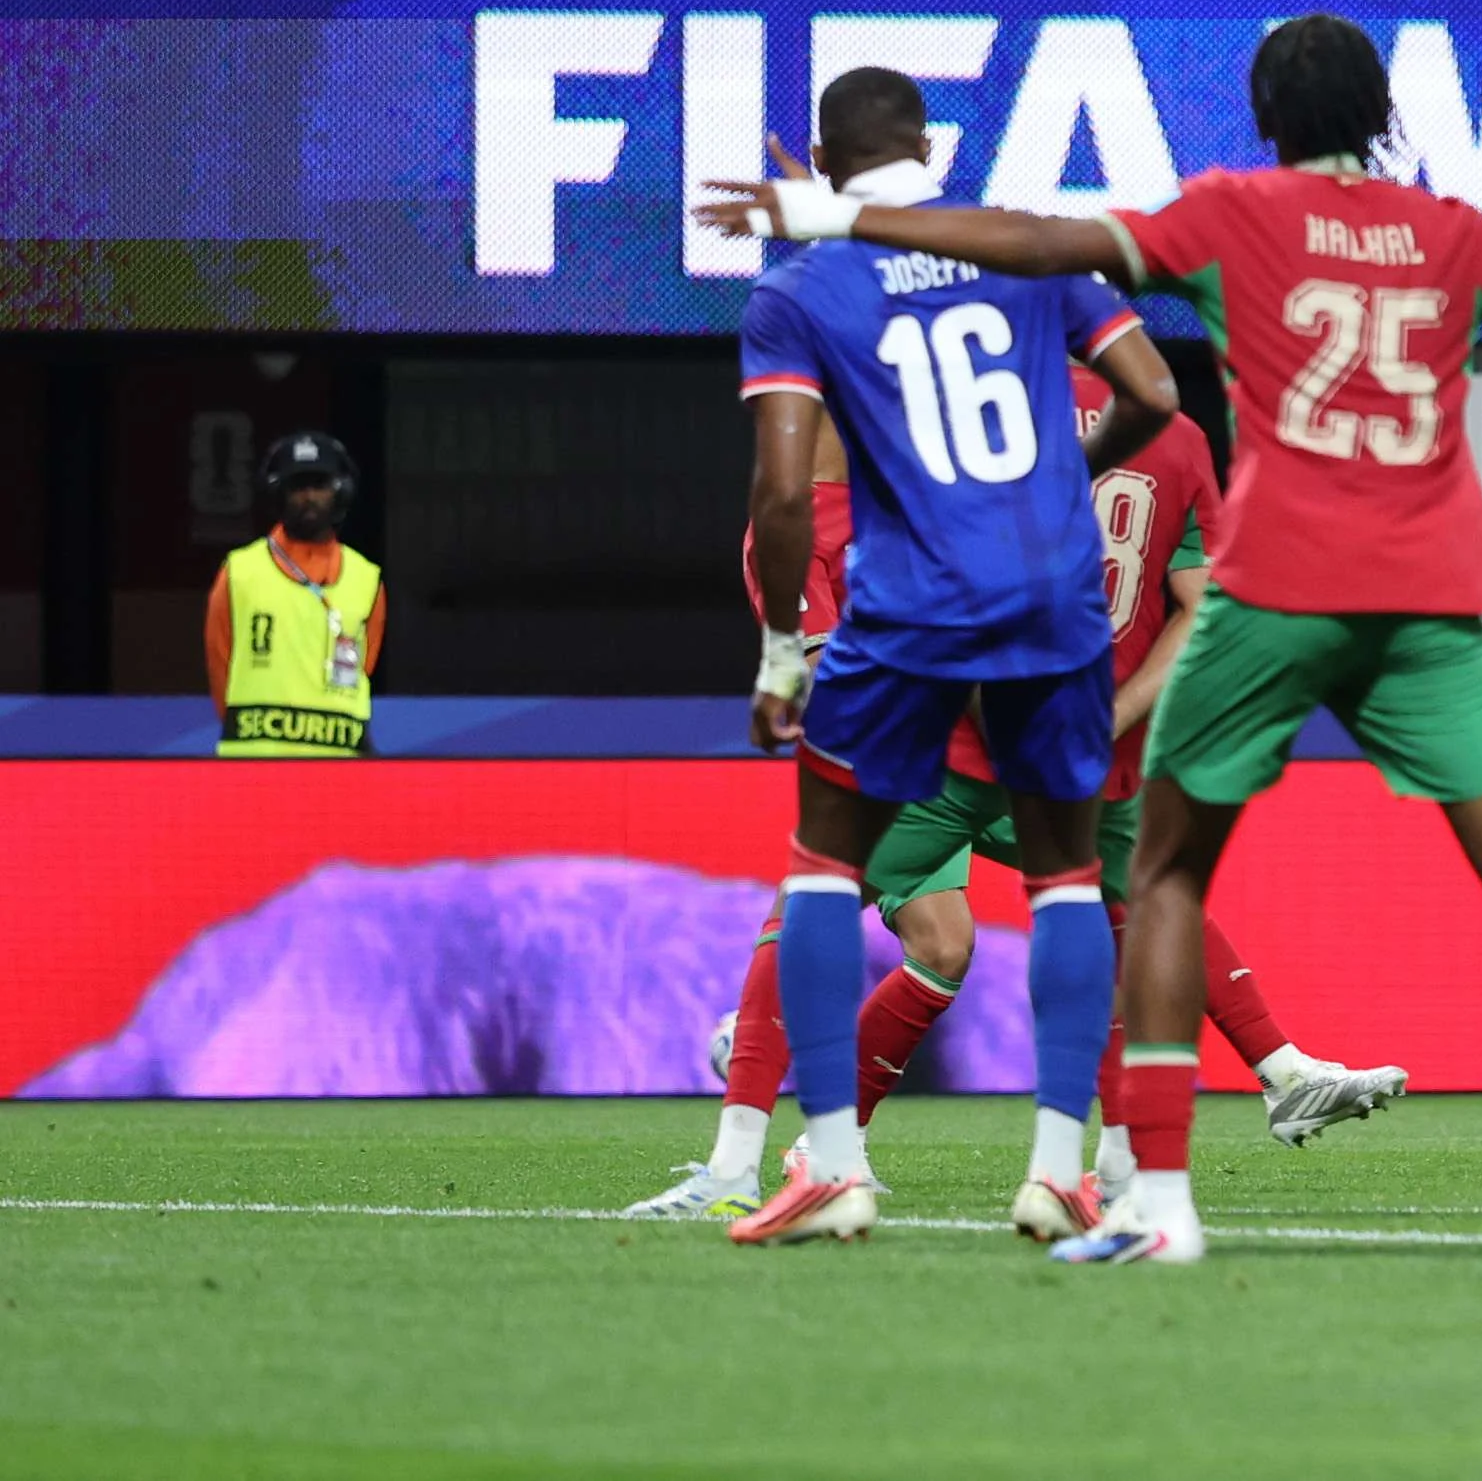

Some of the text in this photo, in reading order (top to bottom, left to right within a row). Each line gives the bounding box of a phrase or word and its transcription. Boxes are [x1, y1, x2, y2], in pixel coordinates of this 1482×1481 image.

[1305, 213, 1426, 266] HALHAL
[876, 301, 1038, 485] 16
[1275, 278, 1449, 467] 25
[236, 708, 364, 747] SECURITY
